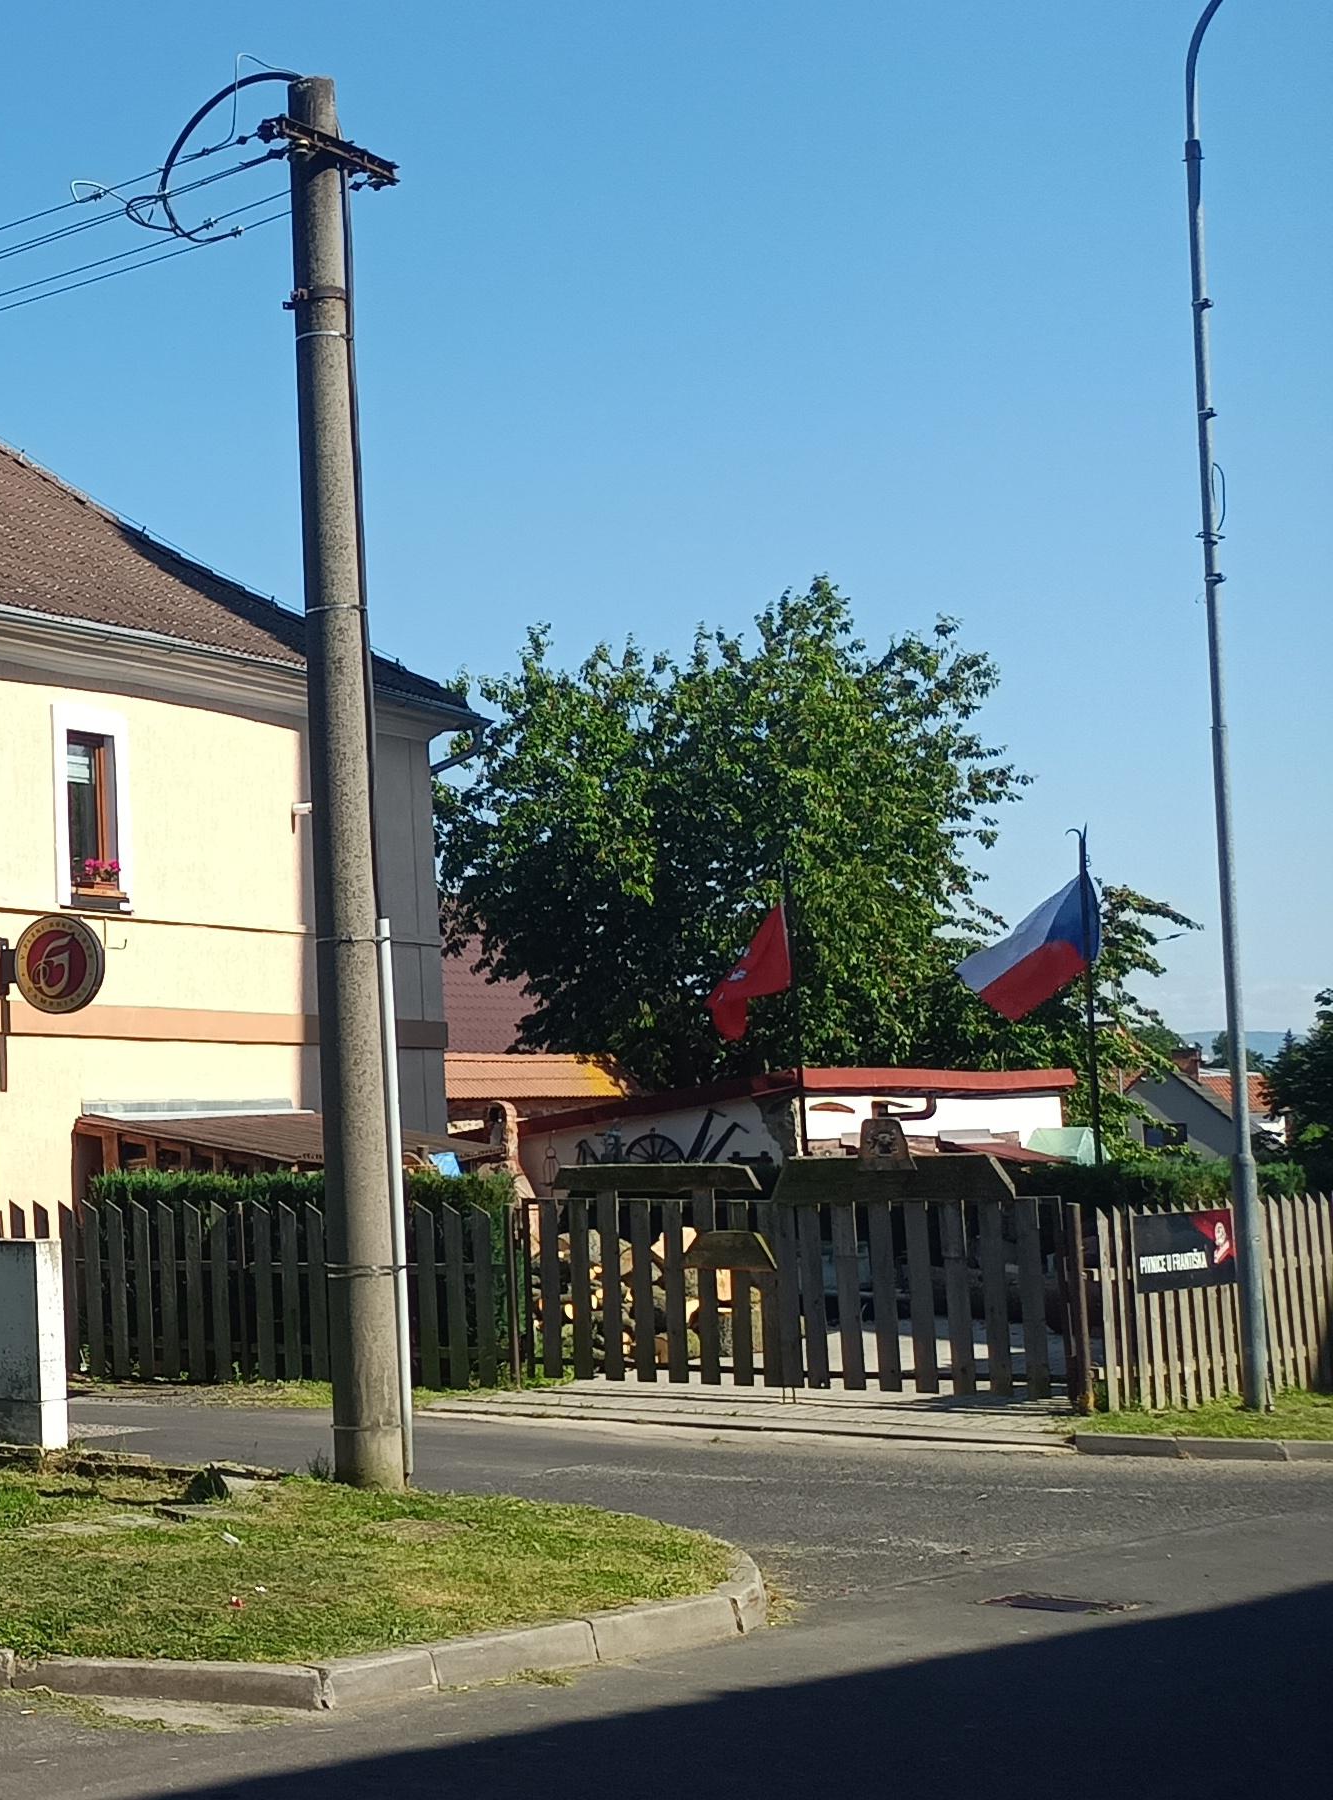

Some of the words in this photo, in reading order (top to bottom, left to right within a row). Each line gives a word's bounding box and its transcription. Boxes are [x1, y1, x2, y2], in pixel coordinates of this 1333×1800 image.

[1139, 1254, 1167, 1275] PIVNICE
[1166, 1254, 1173, 1272] U
[1172, 1247, 1209, 1272] FRANTIŠKA
